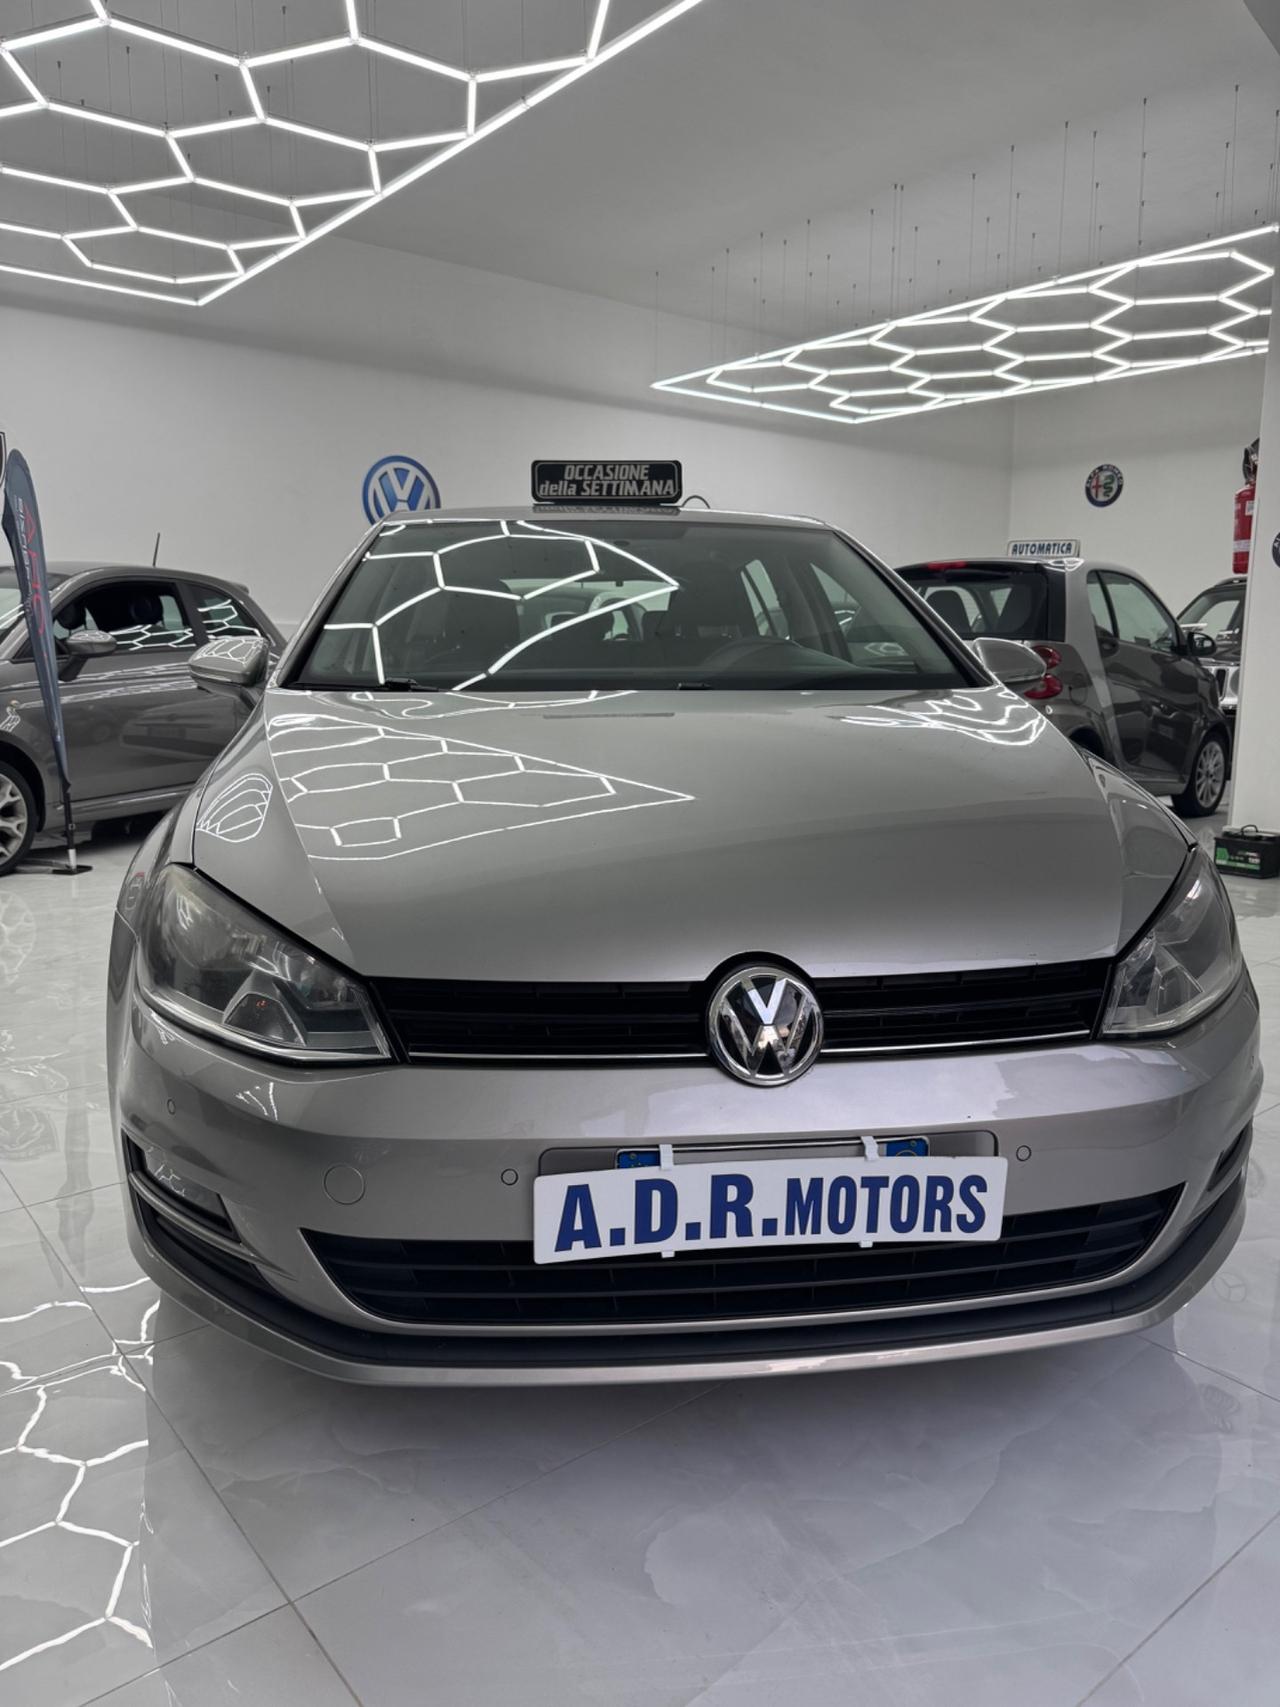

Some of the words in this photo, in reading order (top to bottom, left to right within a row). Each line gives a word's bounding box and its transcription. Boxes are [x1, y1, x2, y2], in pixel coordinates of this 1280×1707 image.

[564, 464, 650, 480] OCCASIONE
[540, 481, 577, 496] della
[580, 480, 674, 496] SETTIMANA
[1012, 543, 1073, 555] AUTOMATICA
[715, 972, 815, 1076] VW
